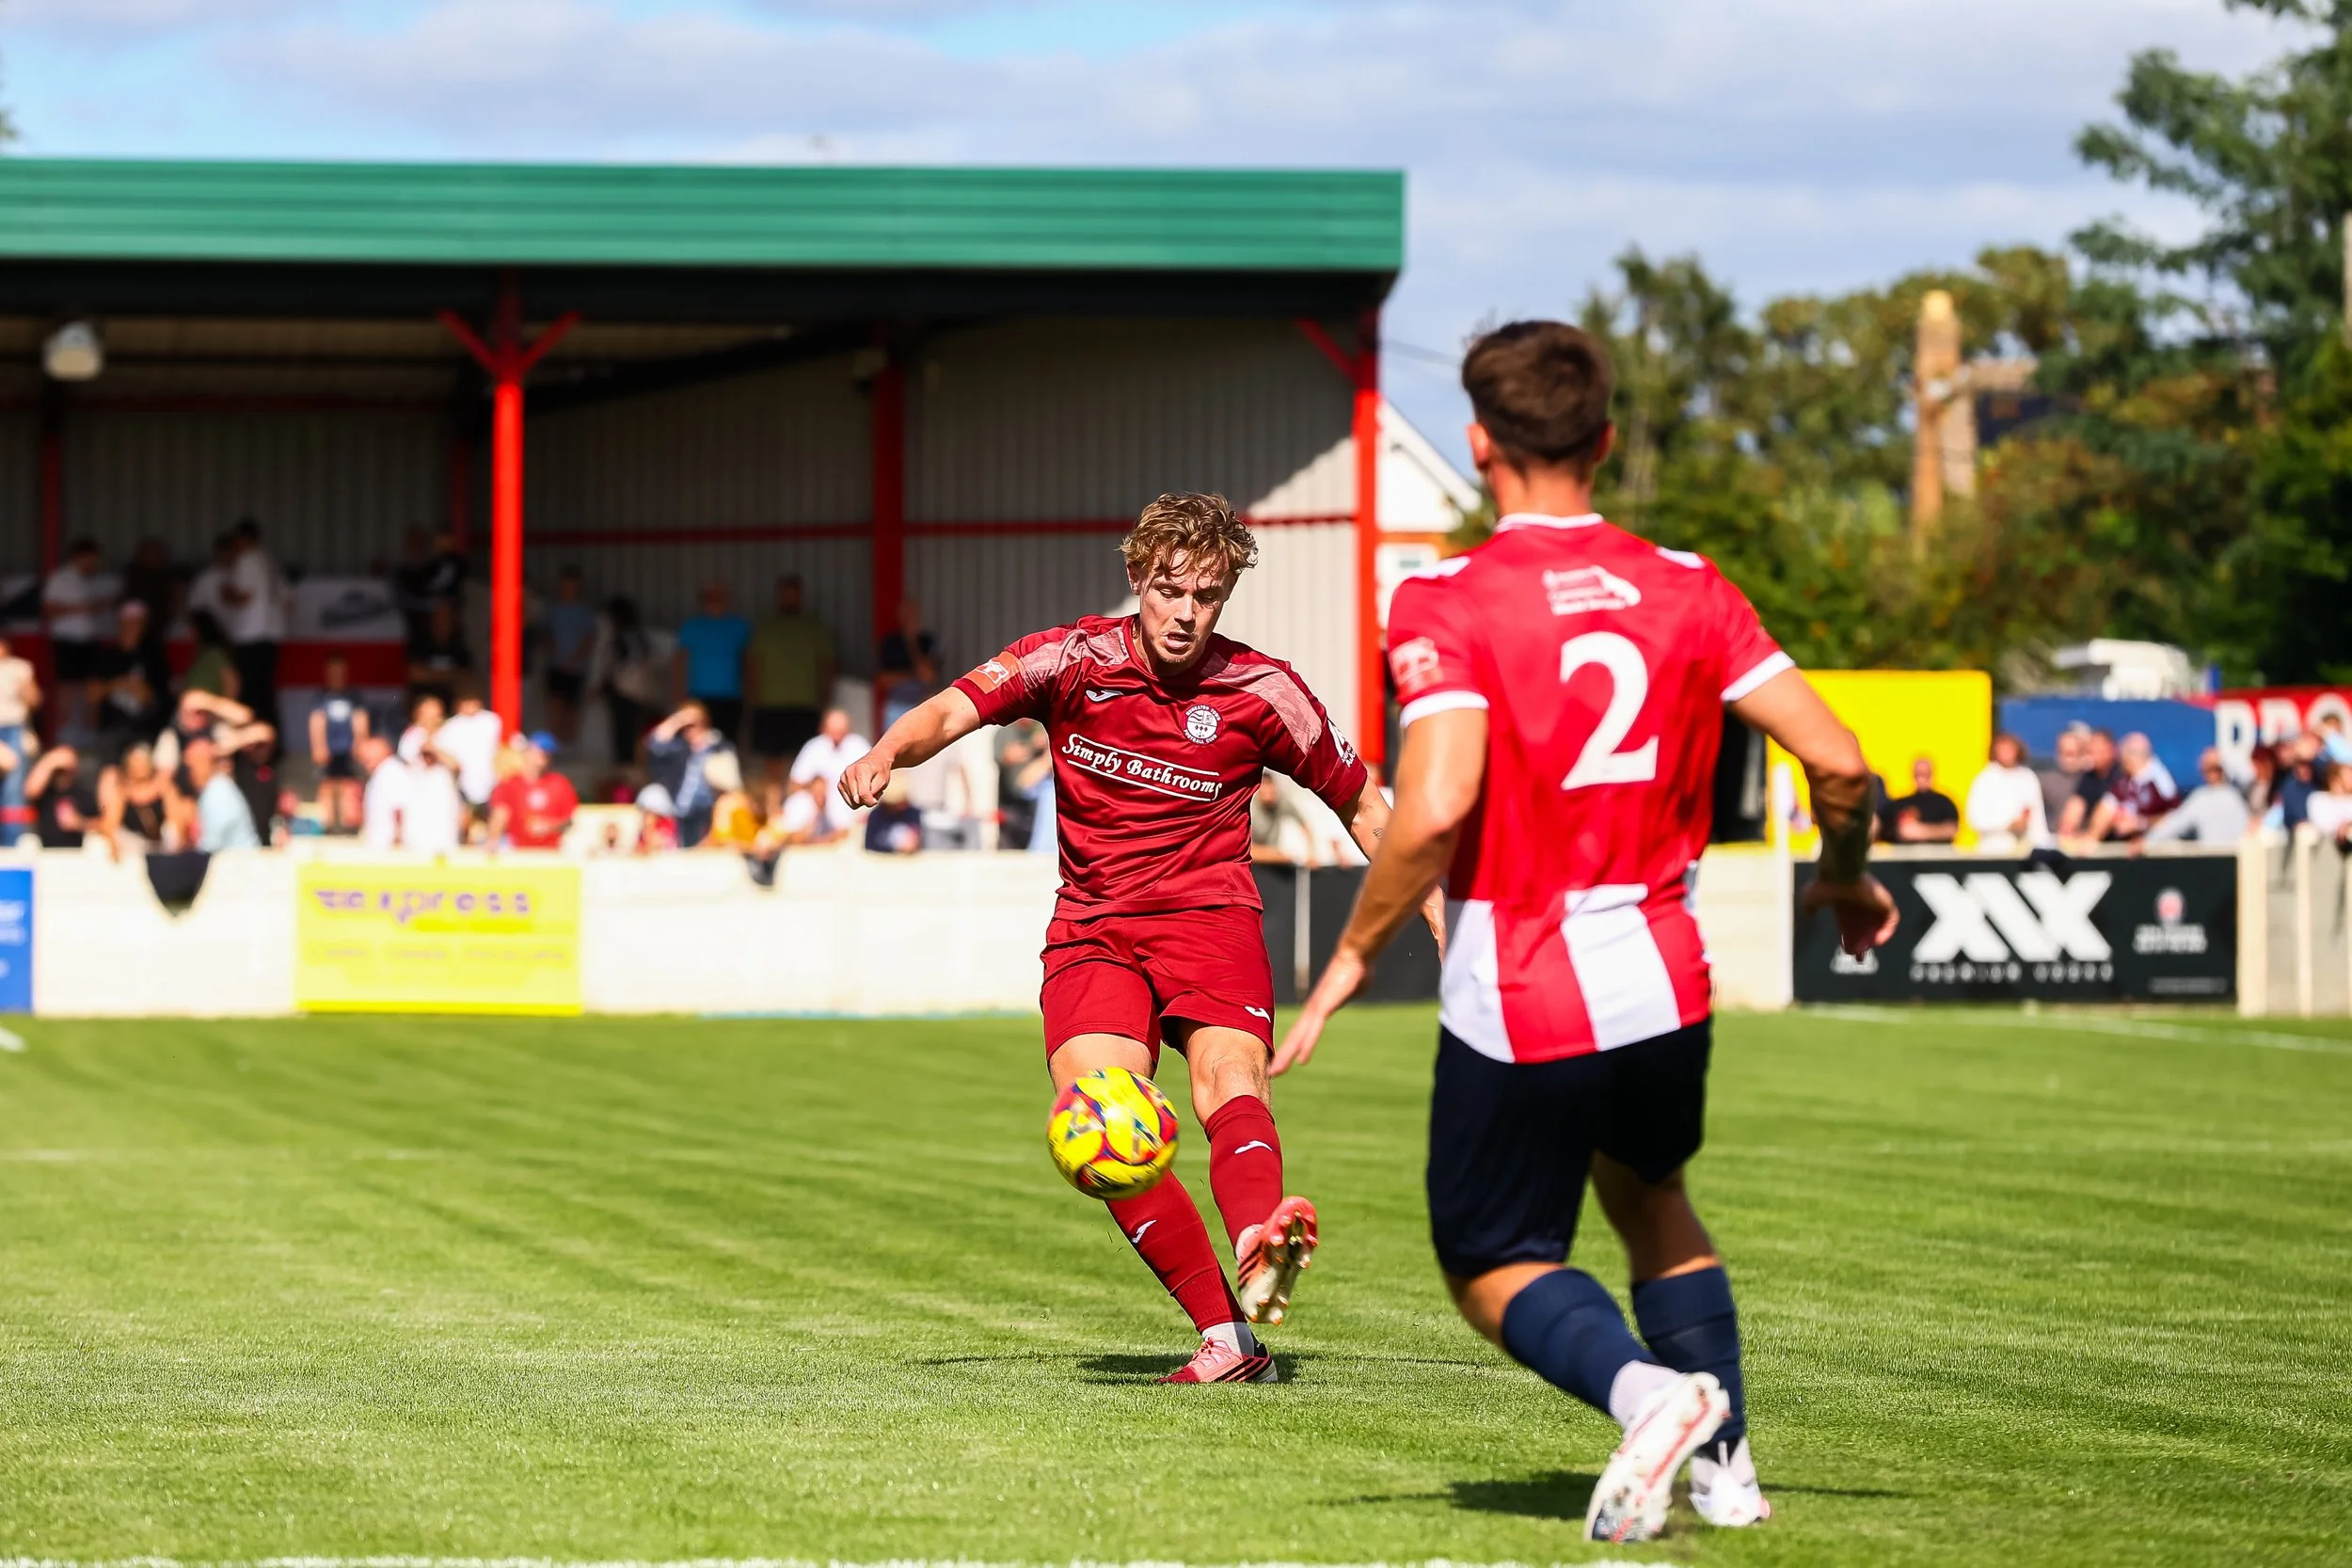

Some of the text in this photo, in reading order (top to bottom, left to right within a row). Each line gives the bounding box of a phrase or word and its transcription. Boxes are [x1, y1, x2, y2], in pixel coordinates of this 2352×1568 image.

[1061, 733, 1223, 801] Simply Bathrooms
[1559, 631, 1659, 790] 2
